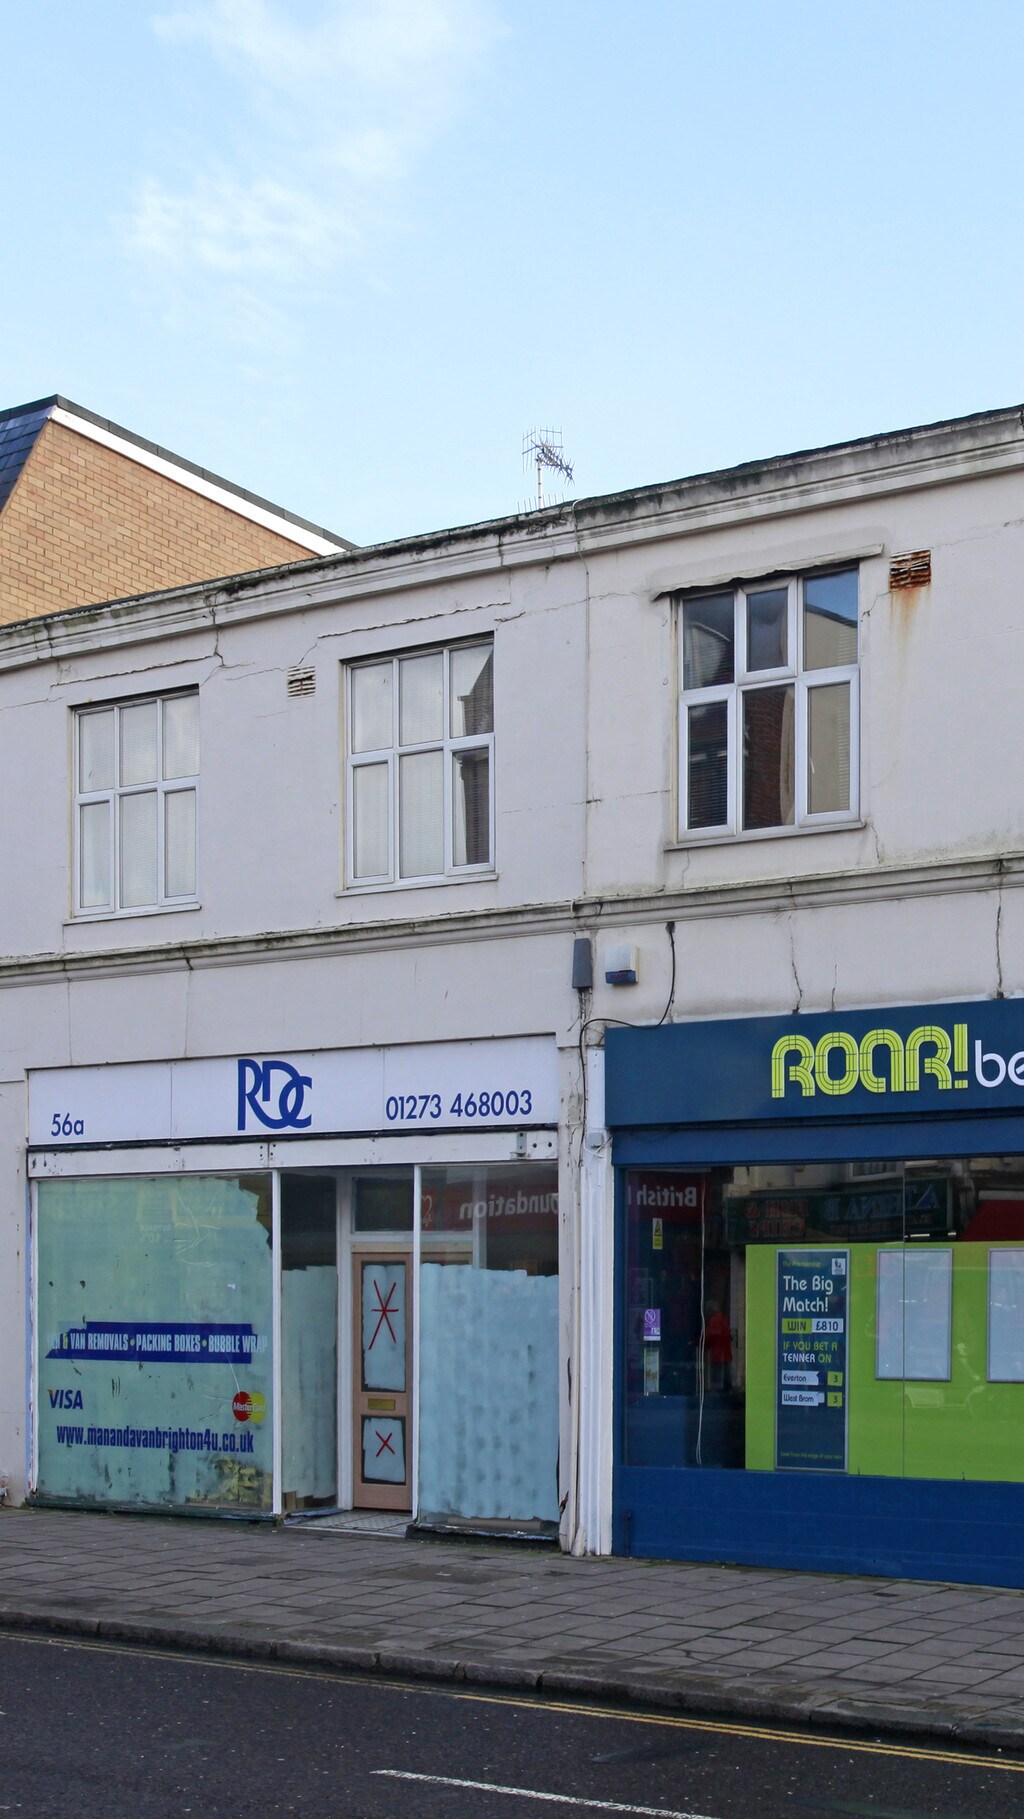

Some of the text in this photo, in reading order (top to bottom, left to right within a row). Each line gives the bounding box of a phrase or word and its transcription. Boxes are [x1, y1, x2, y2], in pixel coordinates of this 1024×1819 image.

[772, 1023, 968, 1098] ROAR!
[386, 1090, 532, 1120] 01273 468003
[51, 1113, 84, 1137] 56a
[783, 1275, 833, 1295] The Big
[783, 1297, 828, 1312] Match!
[787, 1321, 839, 1331] WIN £810
[70, 1333, 85, 1350] VAN
[88, 1333, 128, 1350] REMOVALS
[136, 1334, 171, 1352] PACKING
[174, 1334, 200, 1352] BOXES
[208, 1335, 240, 1353] BUBBLE
[242, 1335, 268, 1353] WRAP
[783, 1341, 838, 1351] IF YOU BET A
[783, 1353, 832, 1363] TENNER ON
[783, 1373, 806, 1382] Everton
[48, 1389, 83, 1410] VISA
[783, 1394, 798, 1402] West
[799, 1394, 814, 1403] Brom
[57, 1425, 254, 1453] www.manandavanbrighton4u.co.uk
